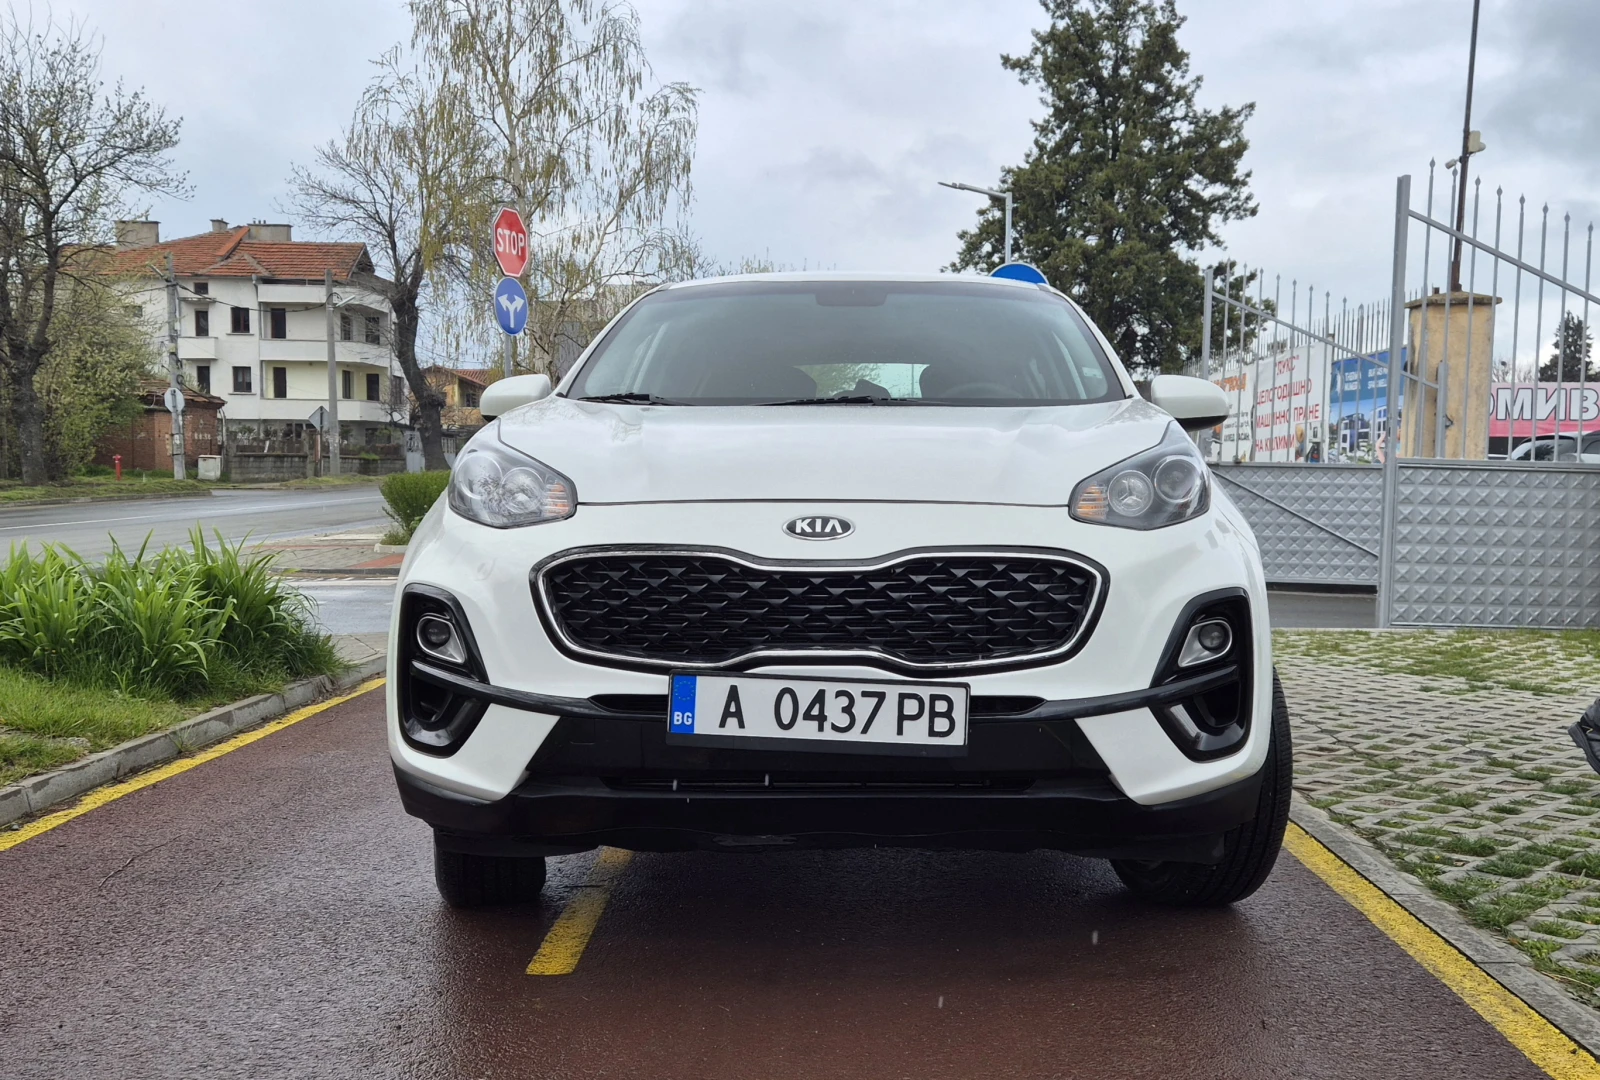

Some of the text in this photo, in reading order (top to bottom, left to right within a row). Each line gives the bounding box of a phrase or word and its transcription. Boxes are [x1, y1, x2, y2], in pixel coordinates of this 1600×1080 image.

[496, 227, 525, 256] STOP
[1490, 387, 1600, 421] МИВ
[1265, 433, 1295, 451] КЛИМИ
[795, 518, 843, 534] KIA
[673, 711, 693, 726] BG
[718, 684, 956, 738] A 0437 PB
